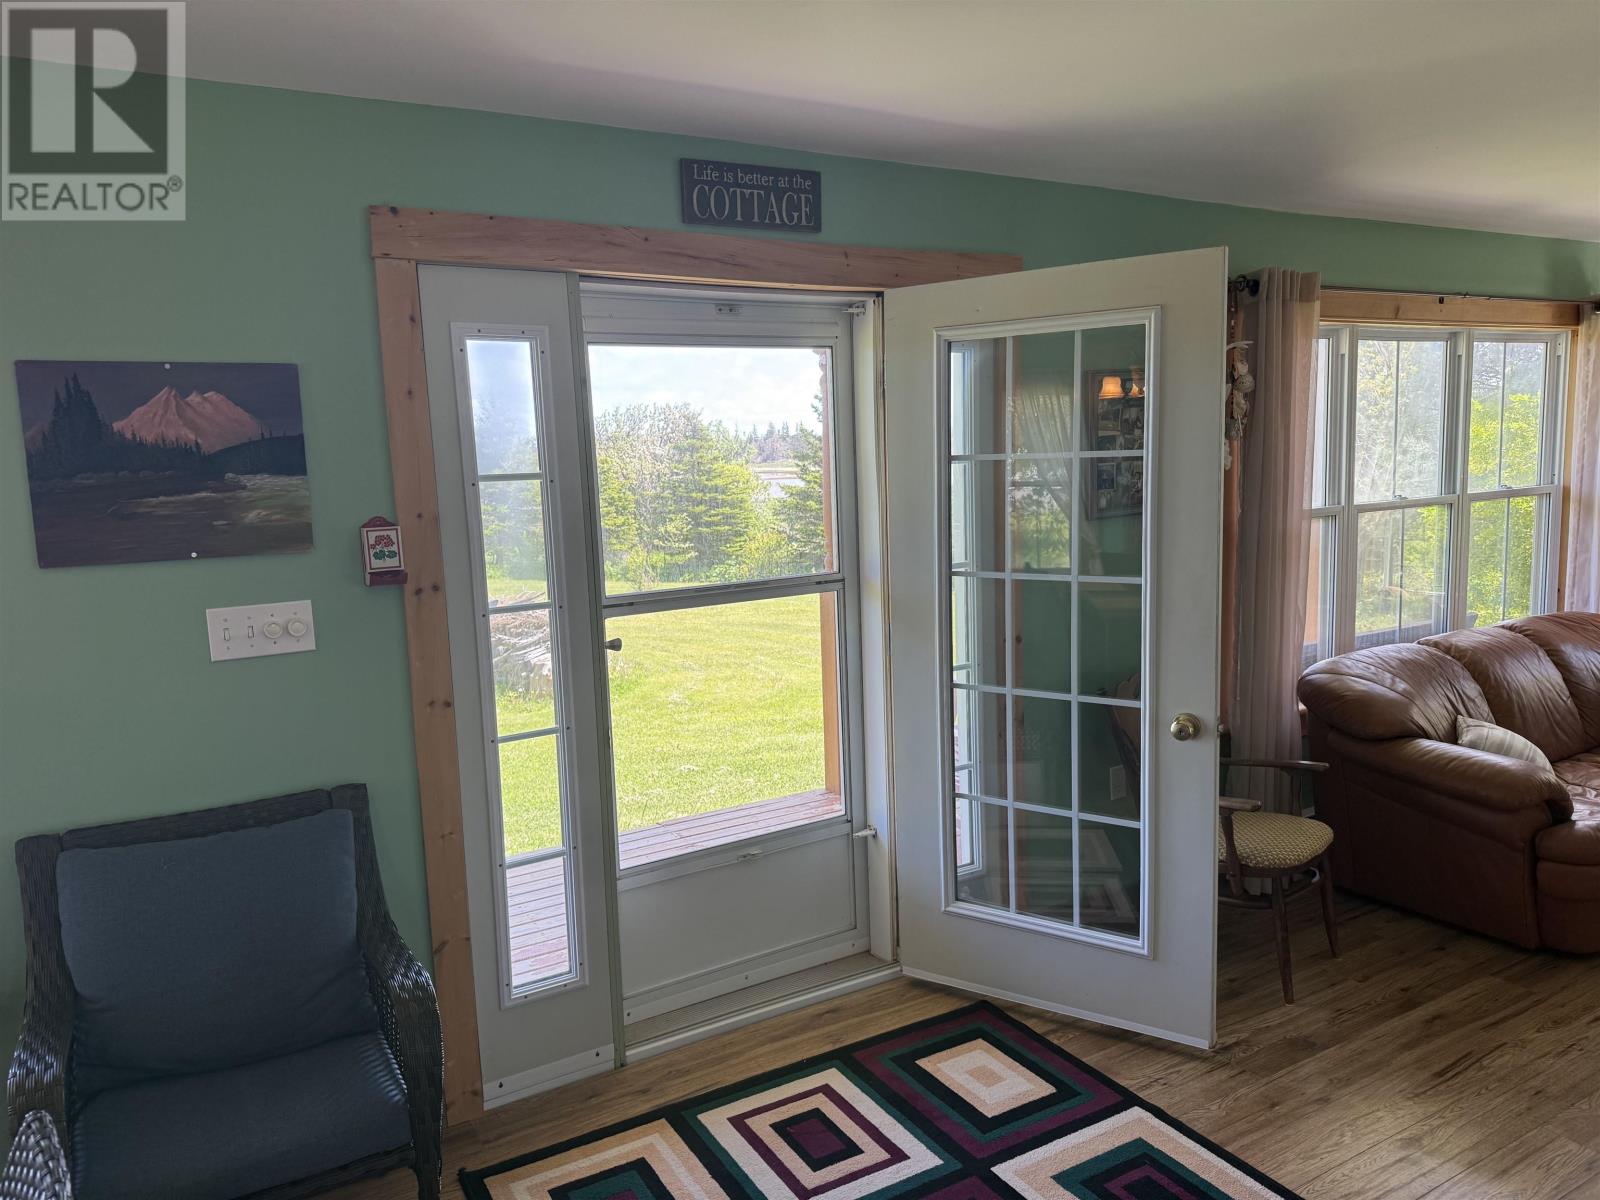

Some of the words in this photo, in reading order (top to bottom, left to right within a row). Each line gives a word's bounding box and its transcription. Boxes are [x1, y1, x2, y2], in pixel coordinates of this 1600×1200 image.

[693, 163, 720, 181] Life
[723, 167, 734, 183] is
[737, 168, 775, 186] better
[778, 175, 790, 189] at
[793, 173, 812, 190] the
[692, 183, 814, 226] COTTAGE
